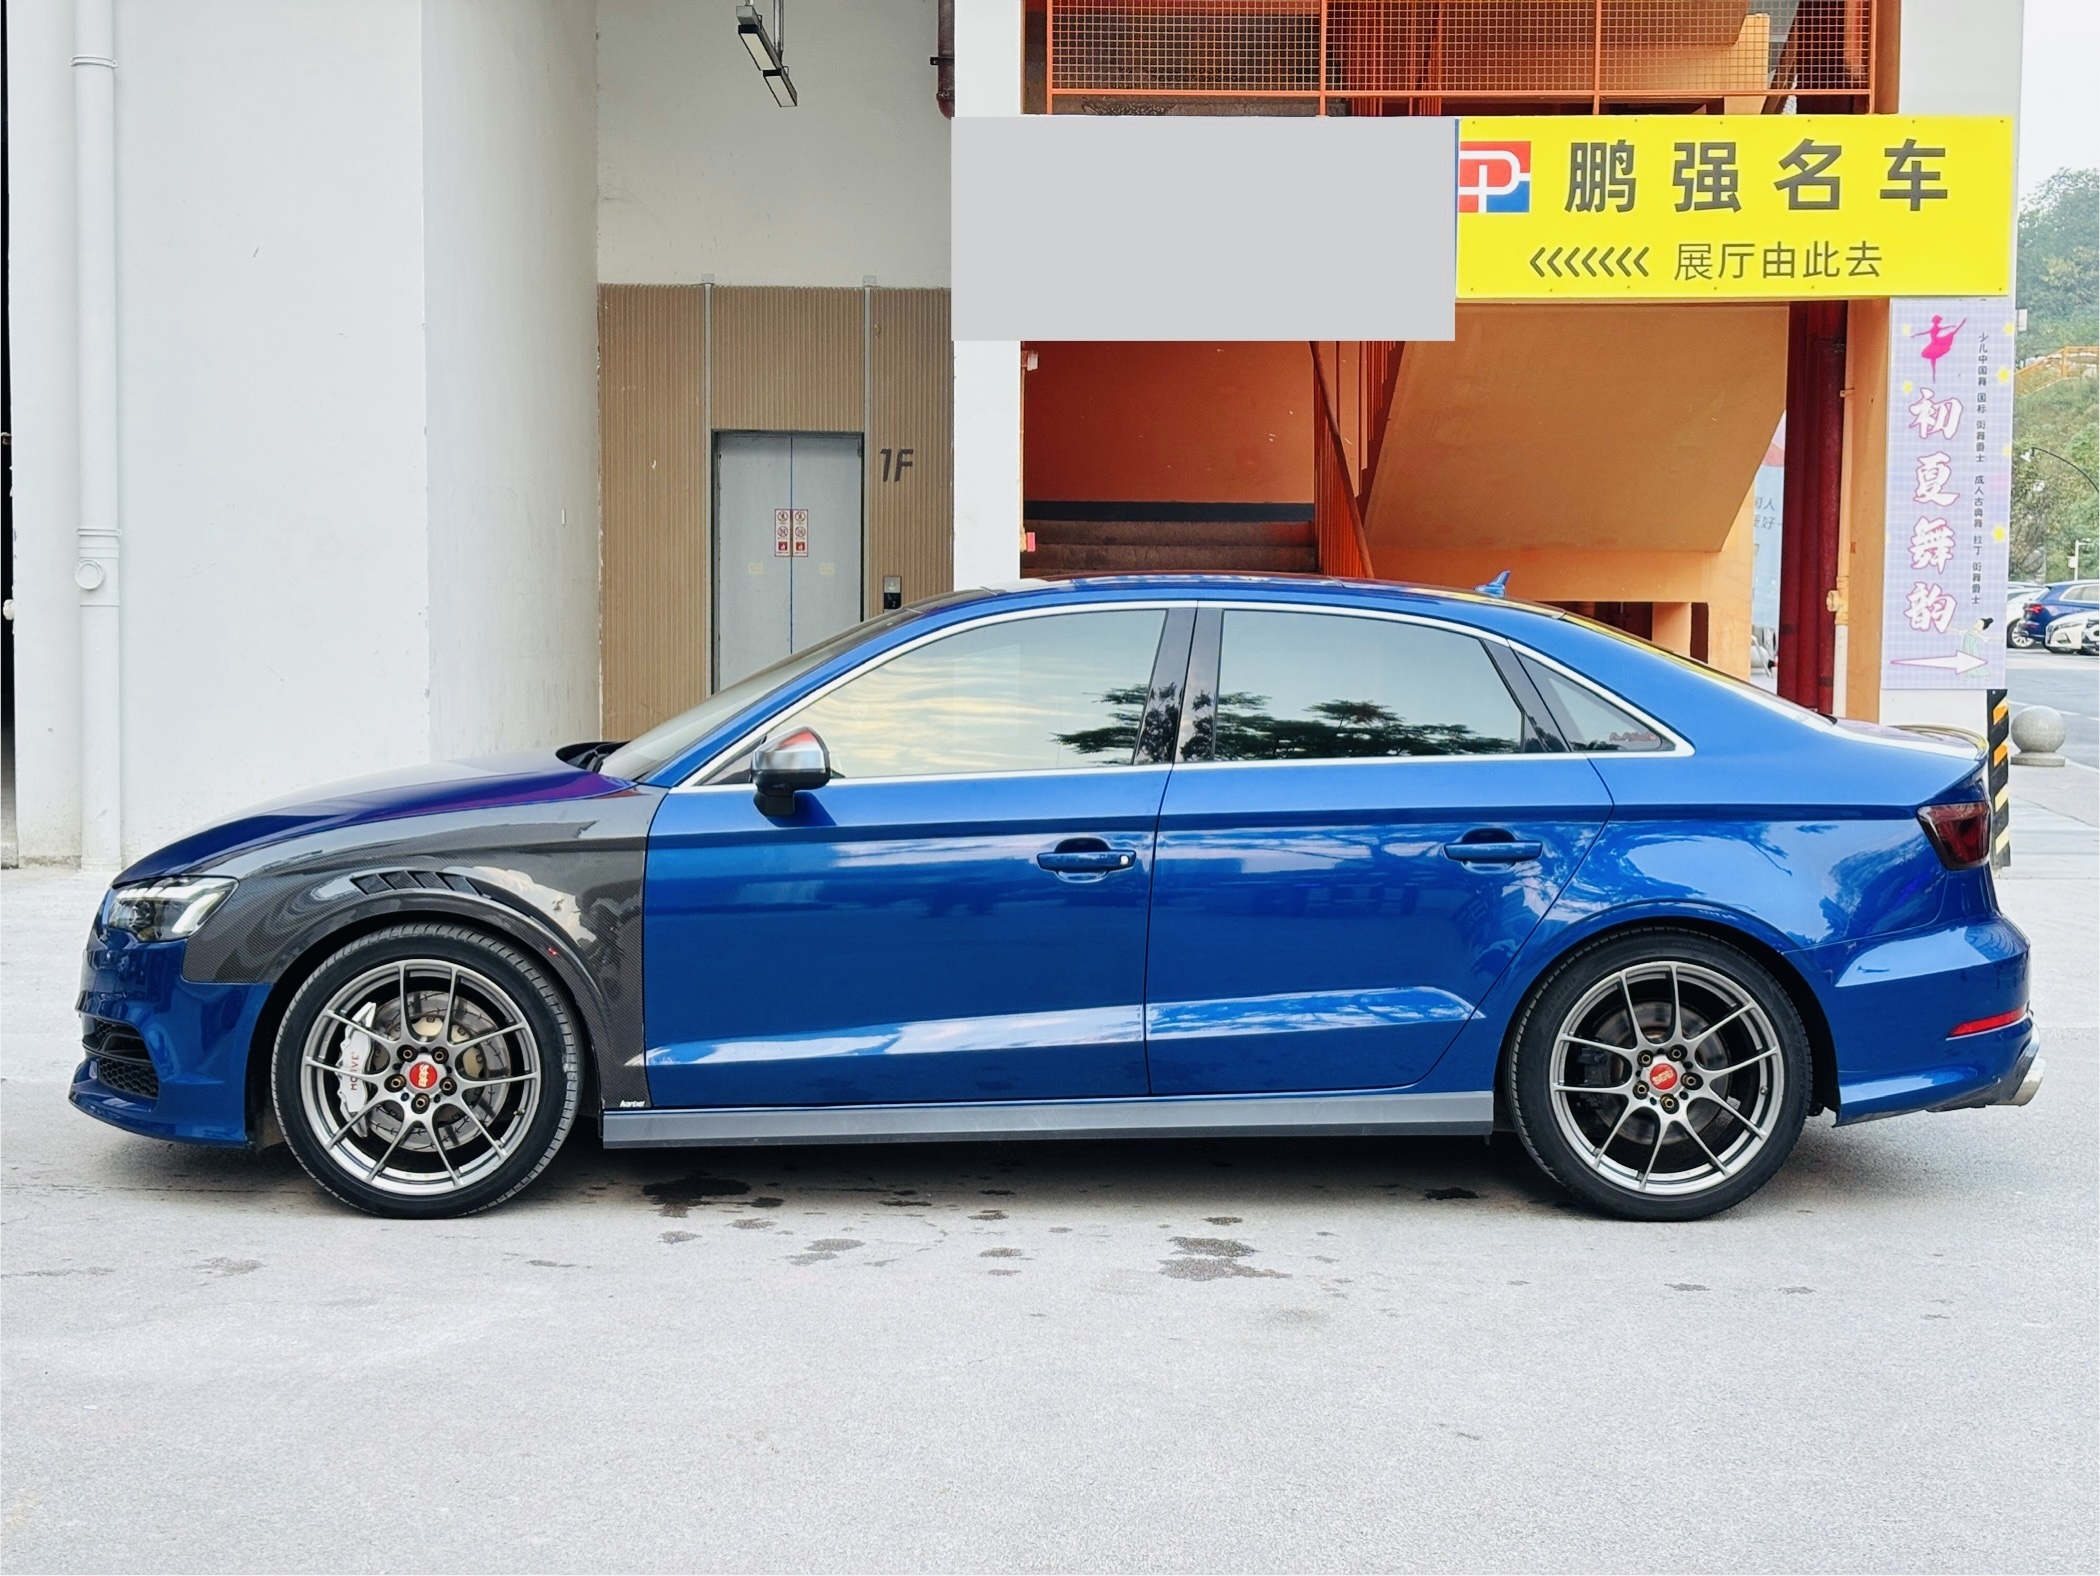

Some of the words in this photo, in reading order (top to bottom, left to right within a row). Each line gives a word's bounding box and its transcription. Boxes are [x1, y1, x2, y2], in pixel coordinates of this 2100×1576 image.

[1564, 138, 1948, 214] 鹏强名车
[1673, 240, 1883, 282] 展厅由此去
[1976, 392, 1987, 414] 国标
[880, 448, 914, 482] 1F
[1903, 387, 1964, 634] 初夏舞韵
[1973, 535, 1983, 556] 拉丁
[350, 1051, 360, 1091] MOIVE
